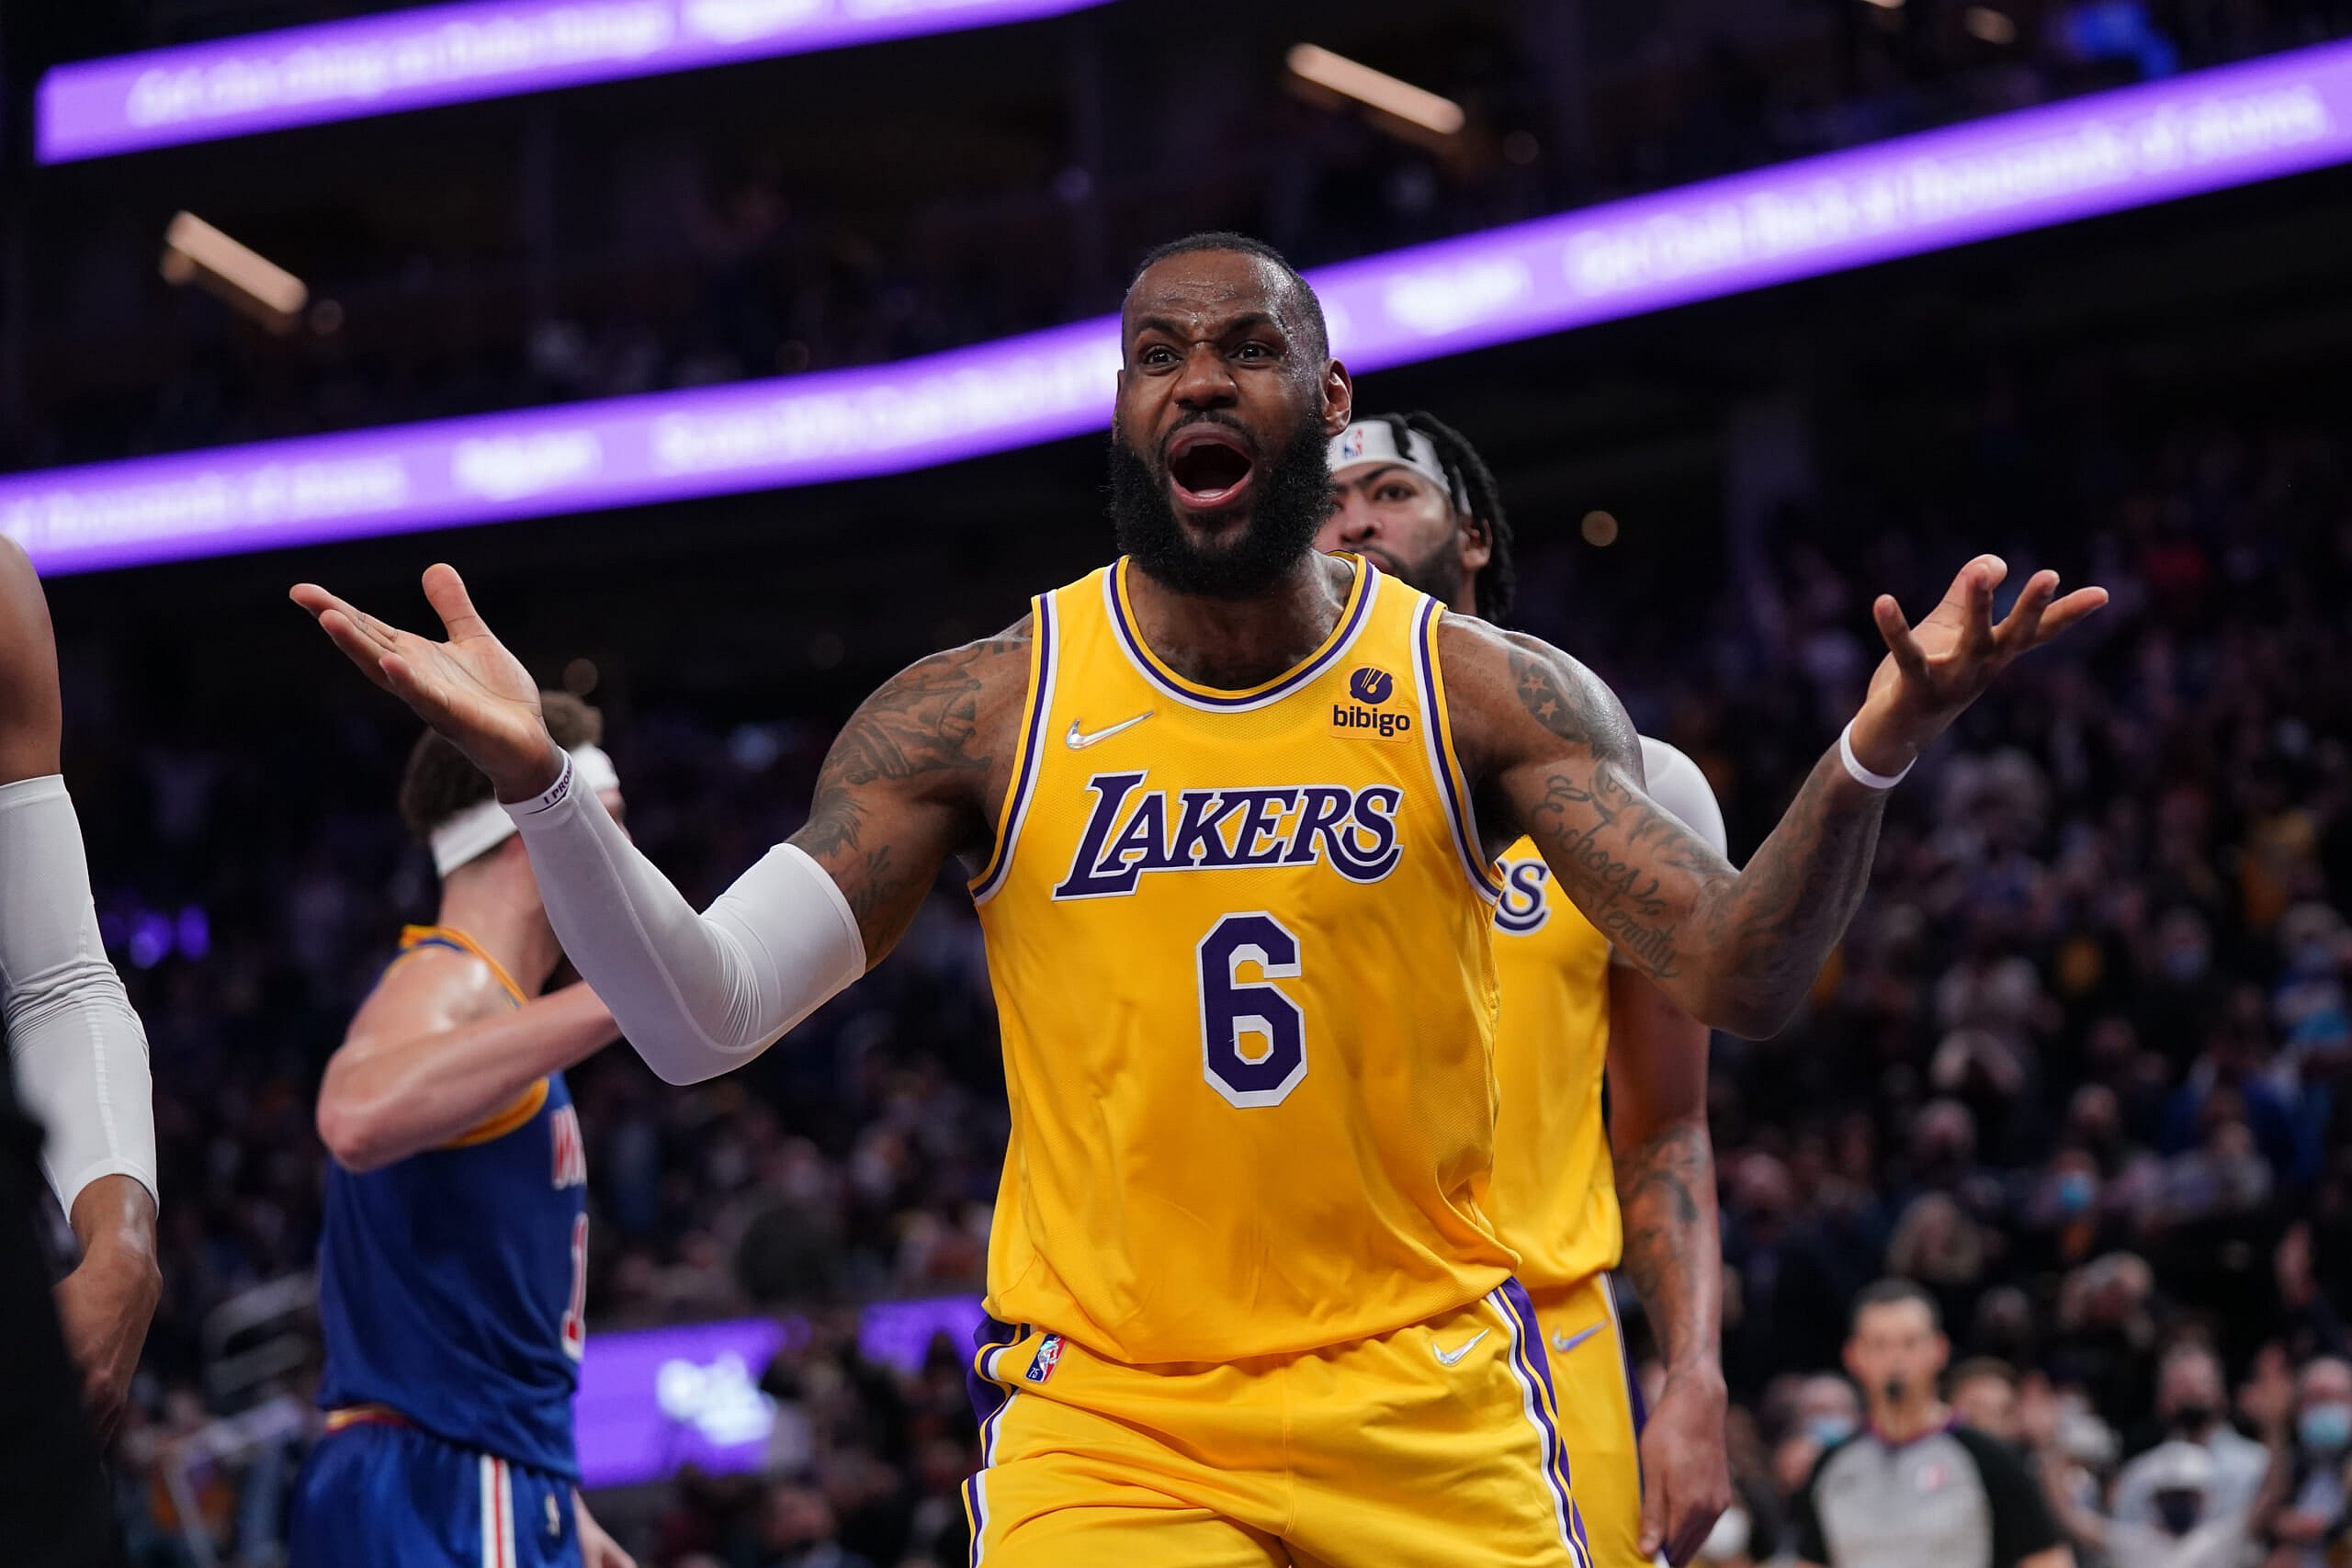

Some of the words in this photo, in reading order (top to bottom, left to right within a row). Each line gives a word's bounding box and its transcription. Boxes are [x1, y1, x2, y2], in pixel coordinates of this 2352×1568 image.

[1333, 705, 1410, 737] bibigo
[1051, 770, 1405, 901] LAKERS
[1195, 910, 1308, 1109] 6
